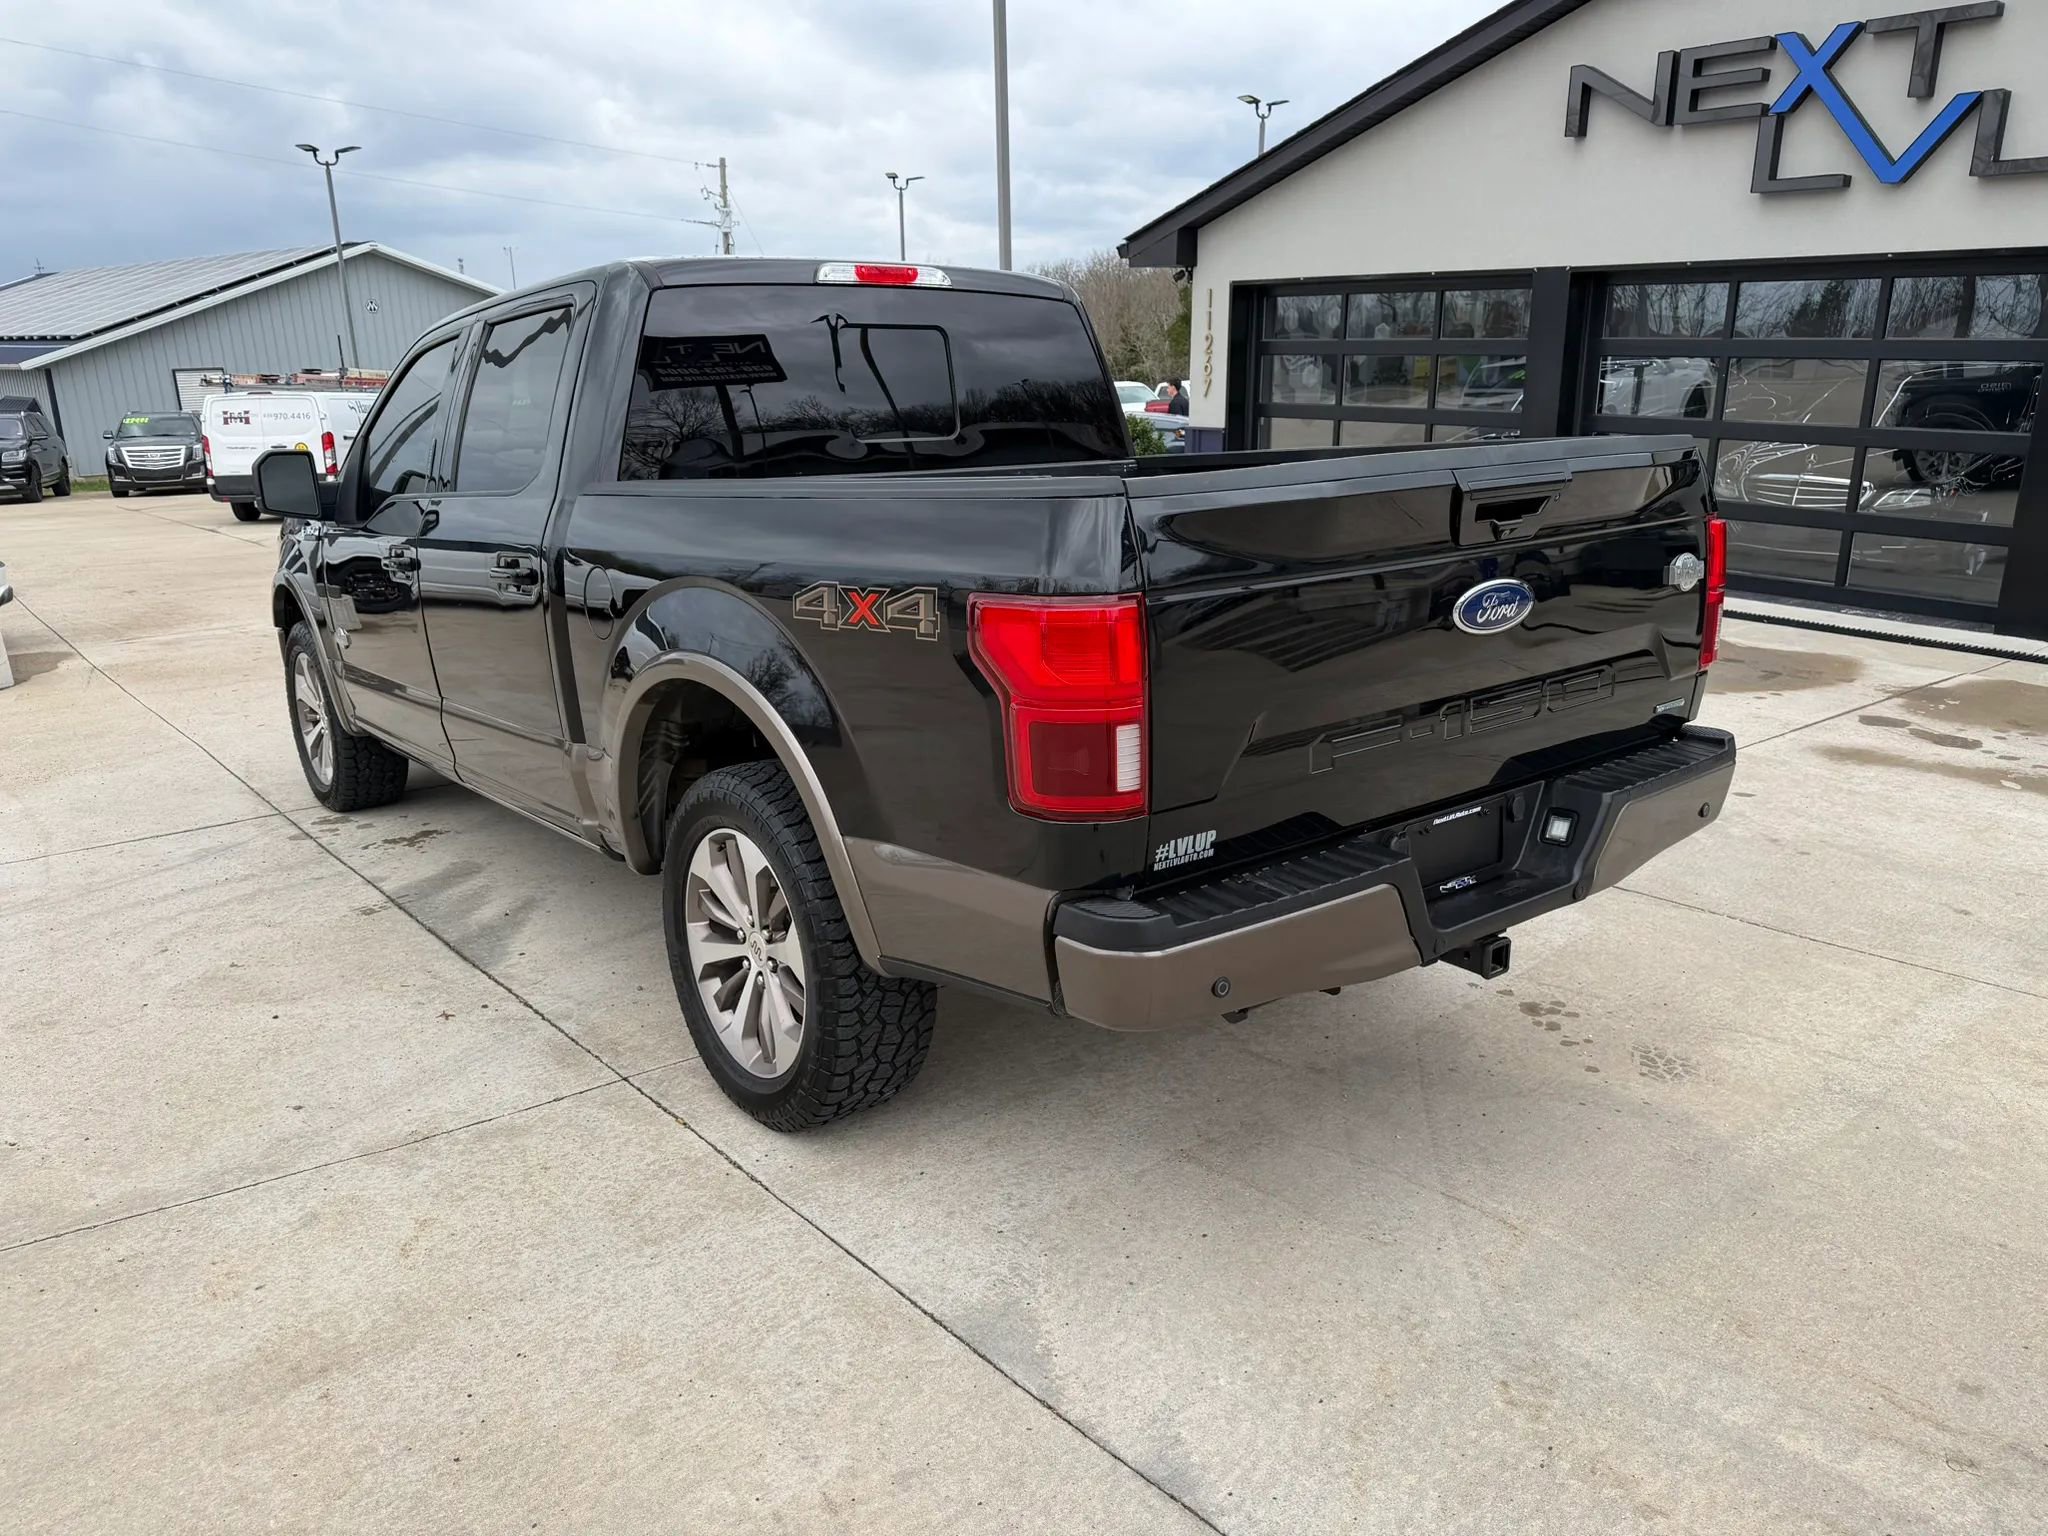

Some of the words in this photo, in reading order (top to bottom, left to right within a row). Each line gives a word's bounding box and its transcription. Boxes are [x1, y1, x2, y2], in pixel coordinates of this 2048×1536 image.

[1564, 0, 2005, 138] NEXT
[1750, 88, 2048, 194] LVL
[1203, 288, 1213, 398] 11267
[1476, 590, 1520, 624] Ford
[1309, 664, 1616, 775] F-150
[1153, 848, 1214, 872] NEXTLVLAUTO.COM
[1155, 829, 1217, 863] #LVLUP
